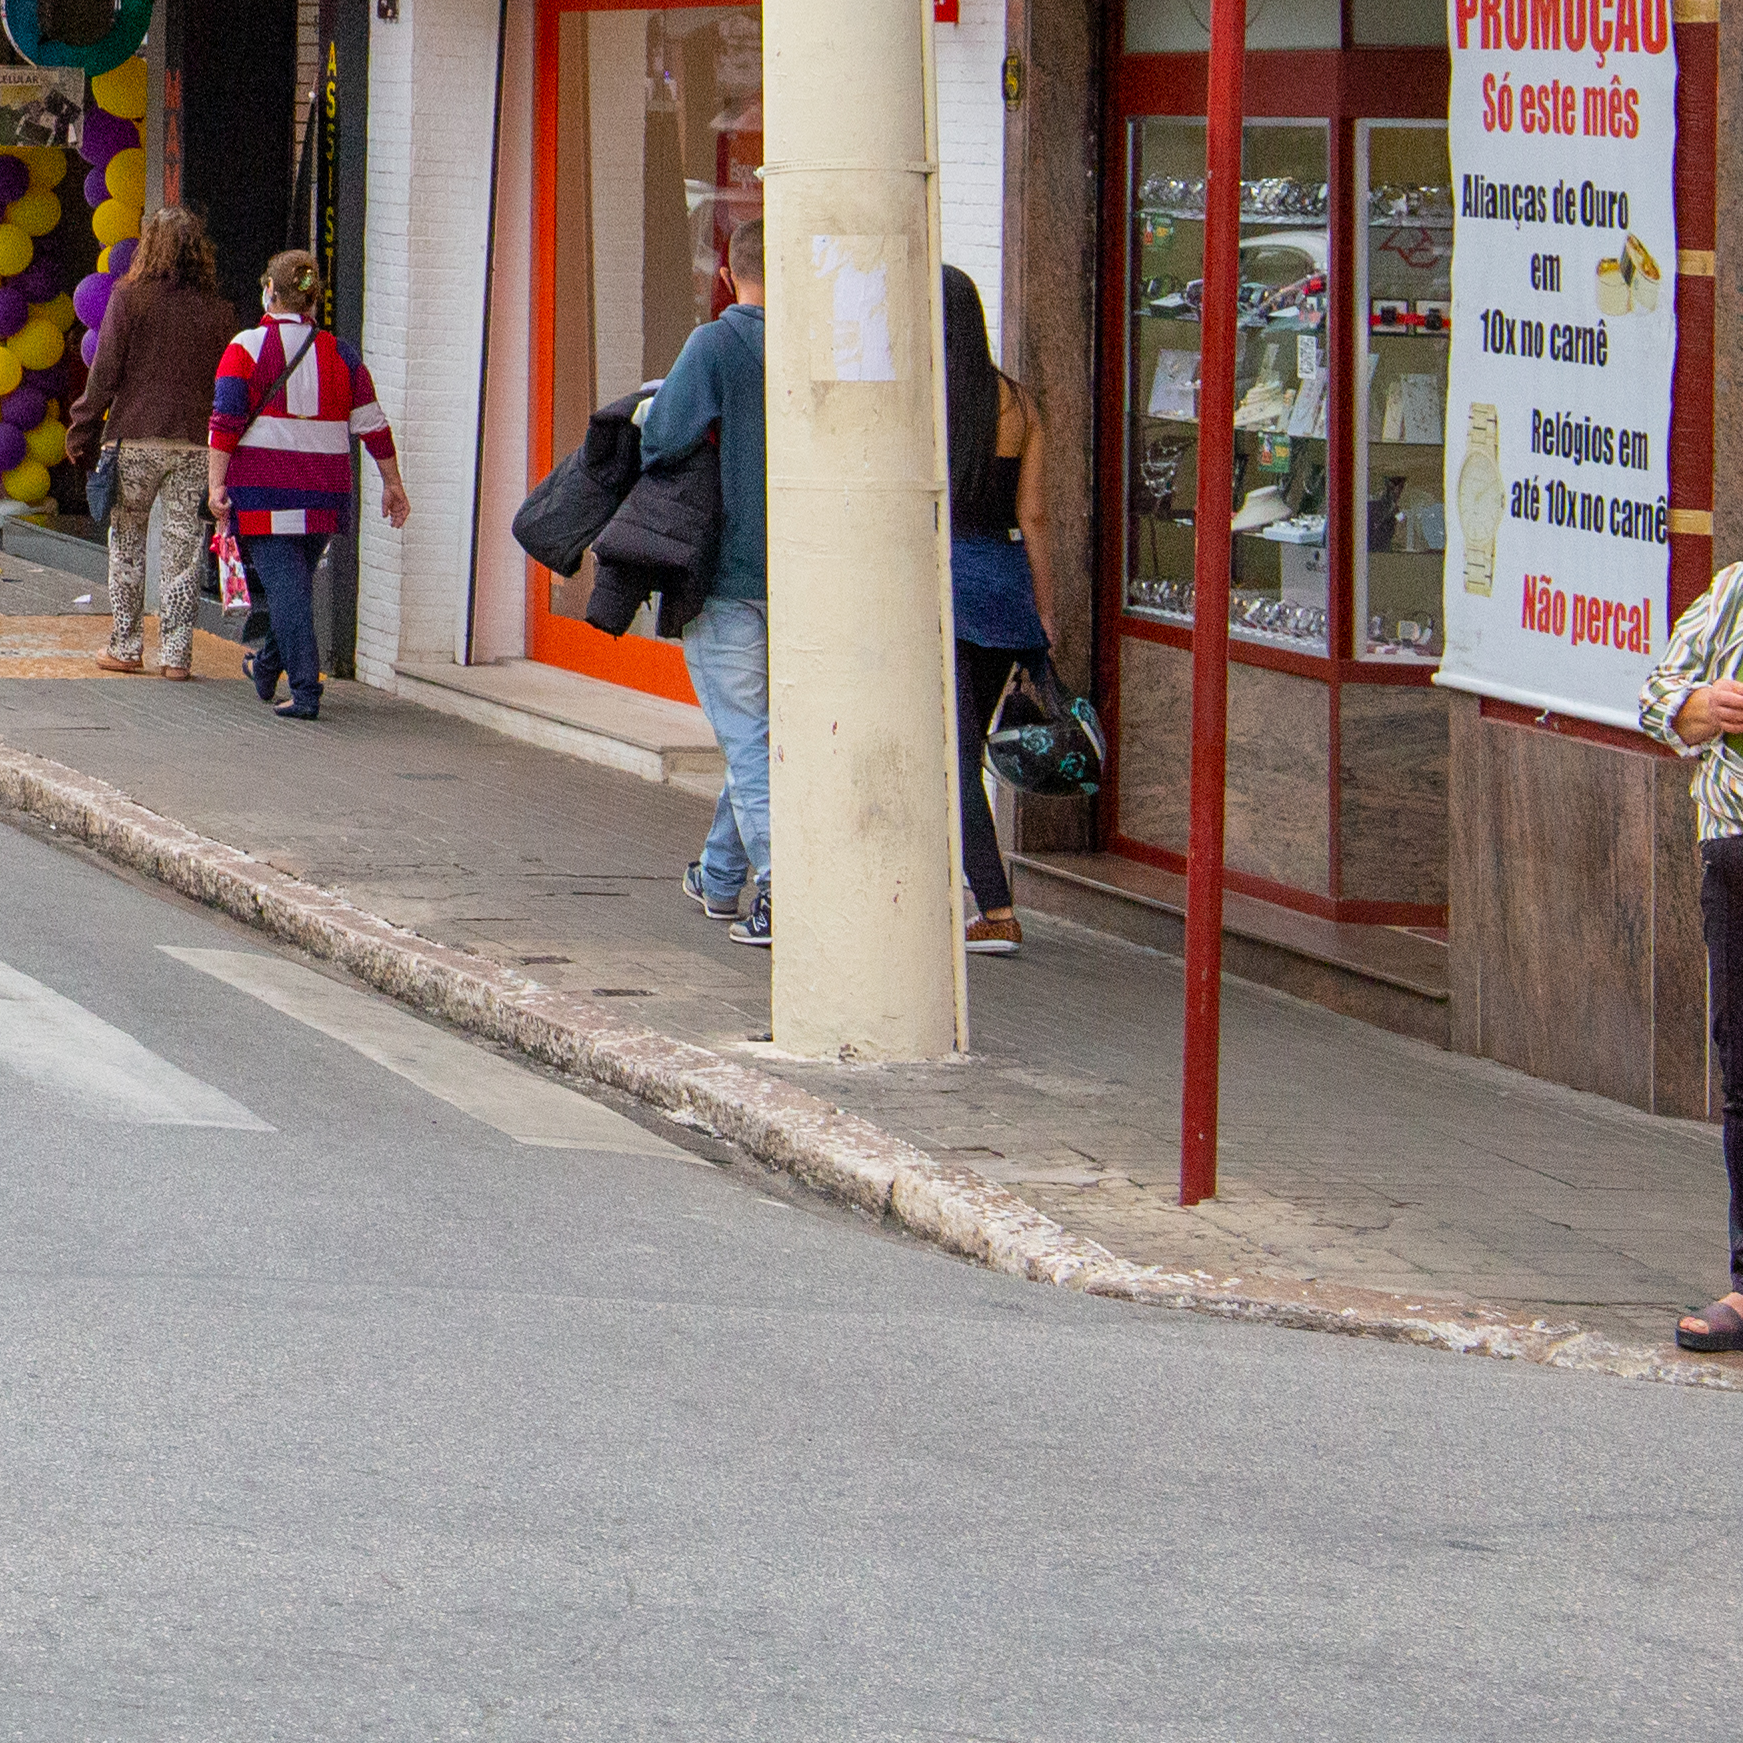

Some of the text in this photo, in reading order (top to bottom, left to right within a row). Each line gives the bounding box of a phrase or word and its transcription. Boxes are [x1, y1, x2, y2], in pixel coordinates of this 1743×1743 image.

[1483, 71, 1639, 140] Só este mês
[1462, 174, 1629, 230] Alianças de Ouro
[1531, 253, 1561, 292] em
[1480, 308, 1608, 367] 10x no carnê
[1531, 408, 1649, 471] Relógios em
[1511, 475, 1668, 545] até 10x no carnê
[1521, 573, 1652, 655] Não perca!
